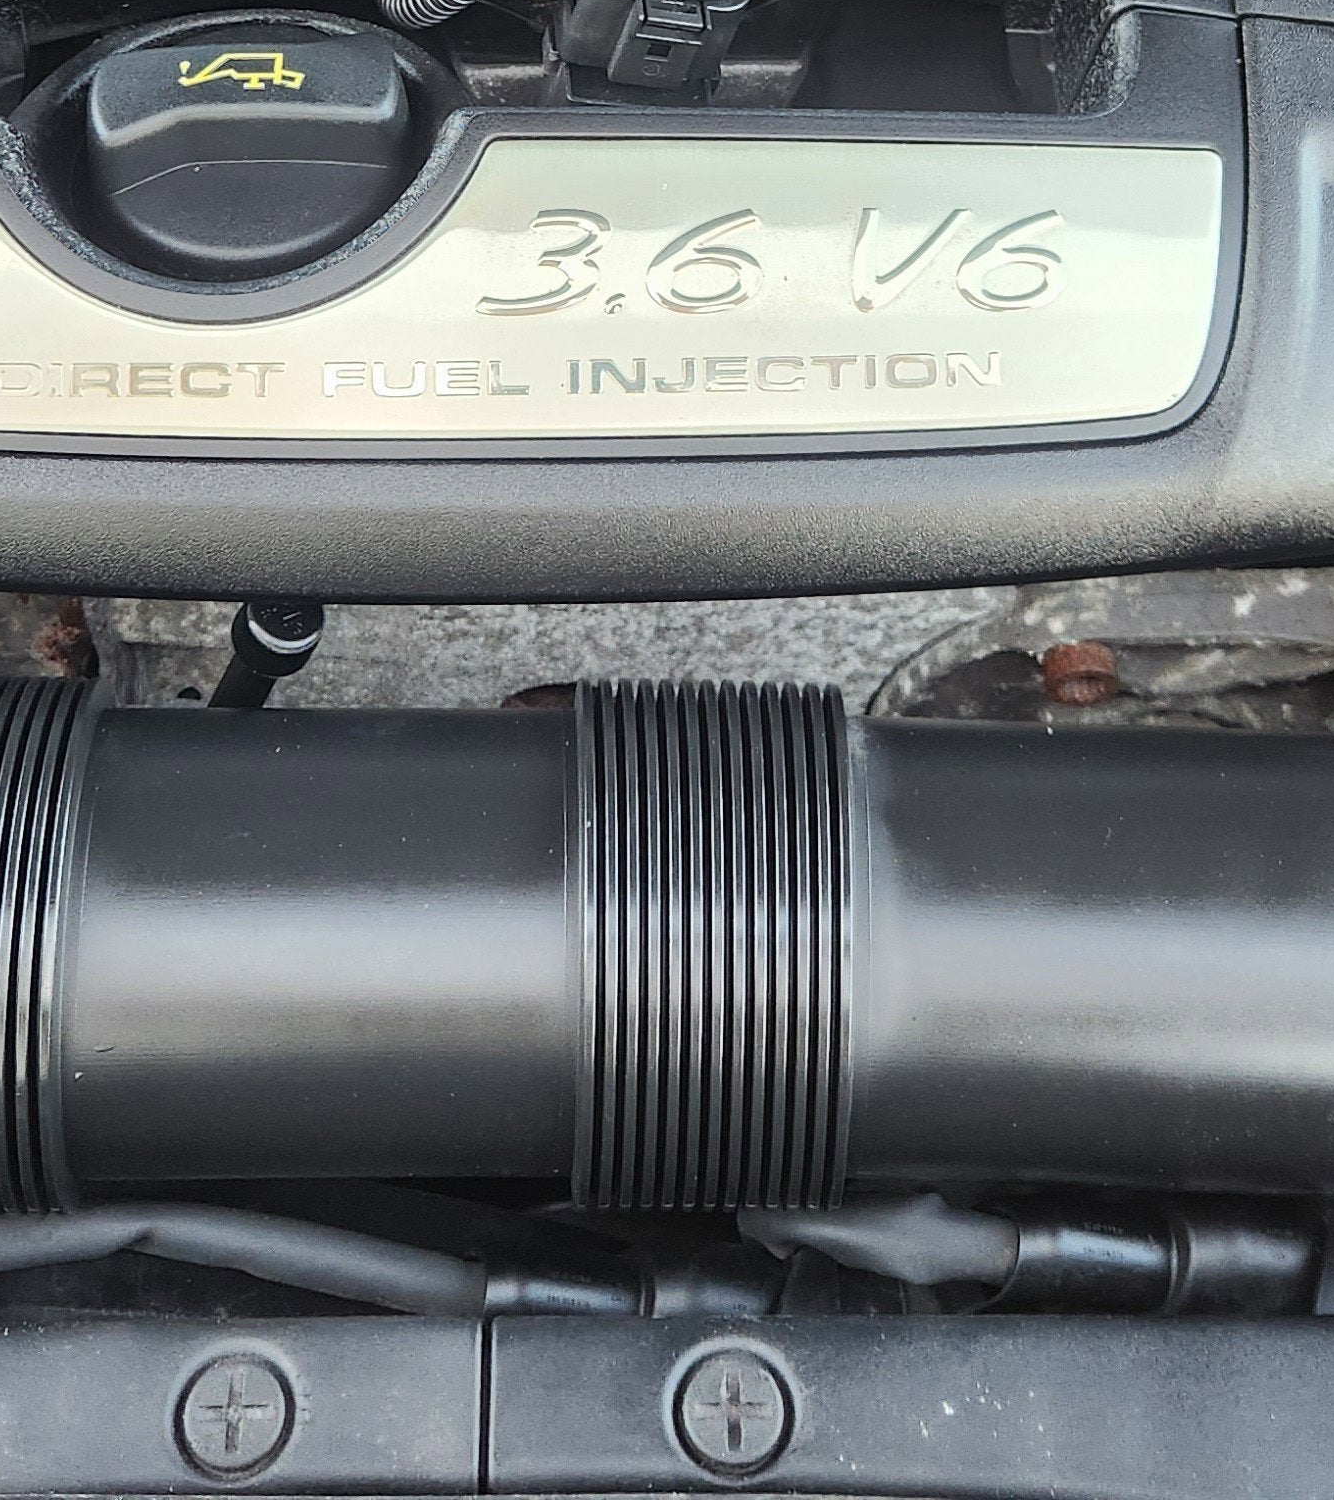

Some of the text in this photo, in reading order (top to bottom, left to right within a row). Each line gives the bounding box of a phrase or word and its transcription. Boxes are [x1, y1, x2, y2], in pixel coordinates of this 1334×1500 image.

[474, 207, 1067, 316] 3.6 V6
[322, 360, 530, 398] FUEL
[566, 351, 1003, 395] INJECTION
